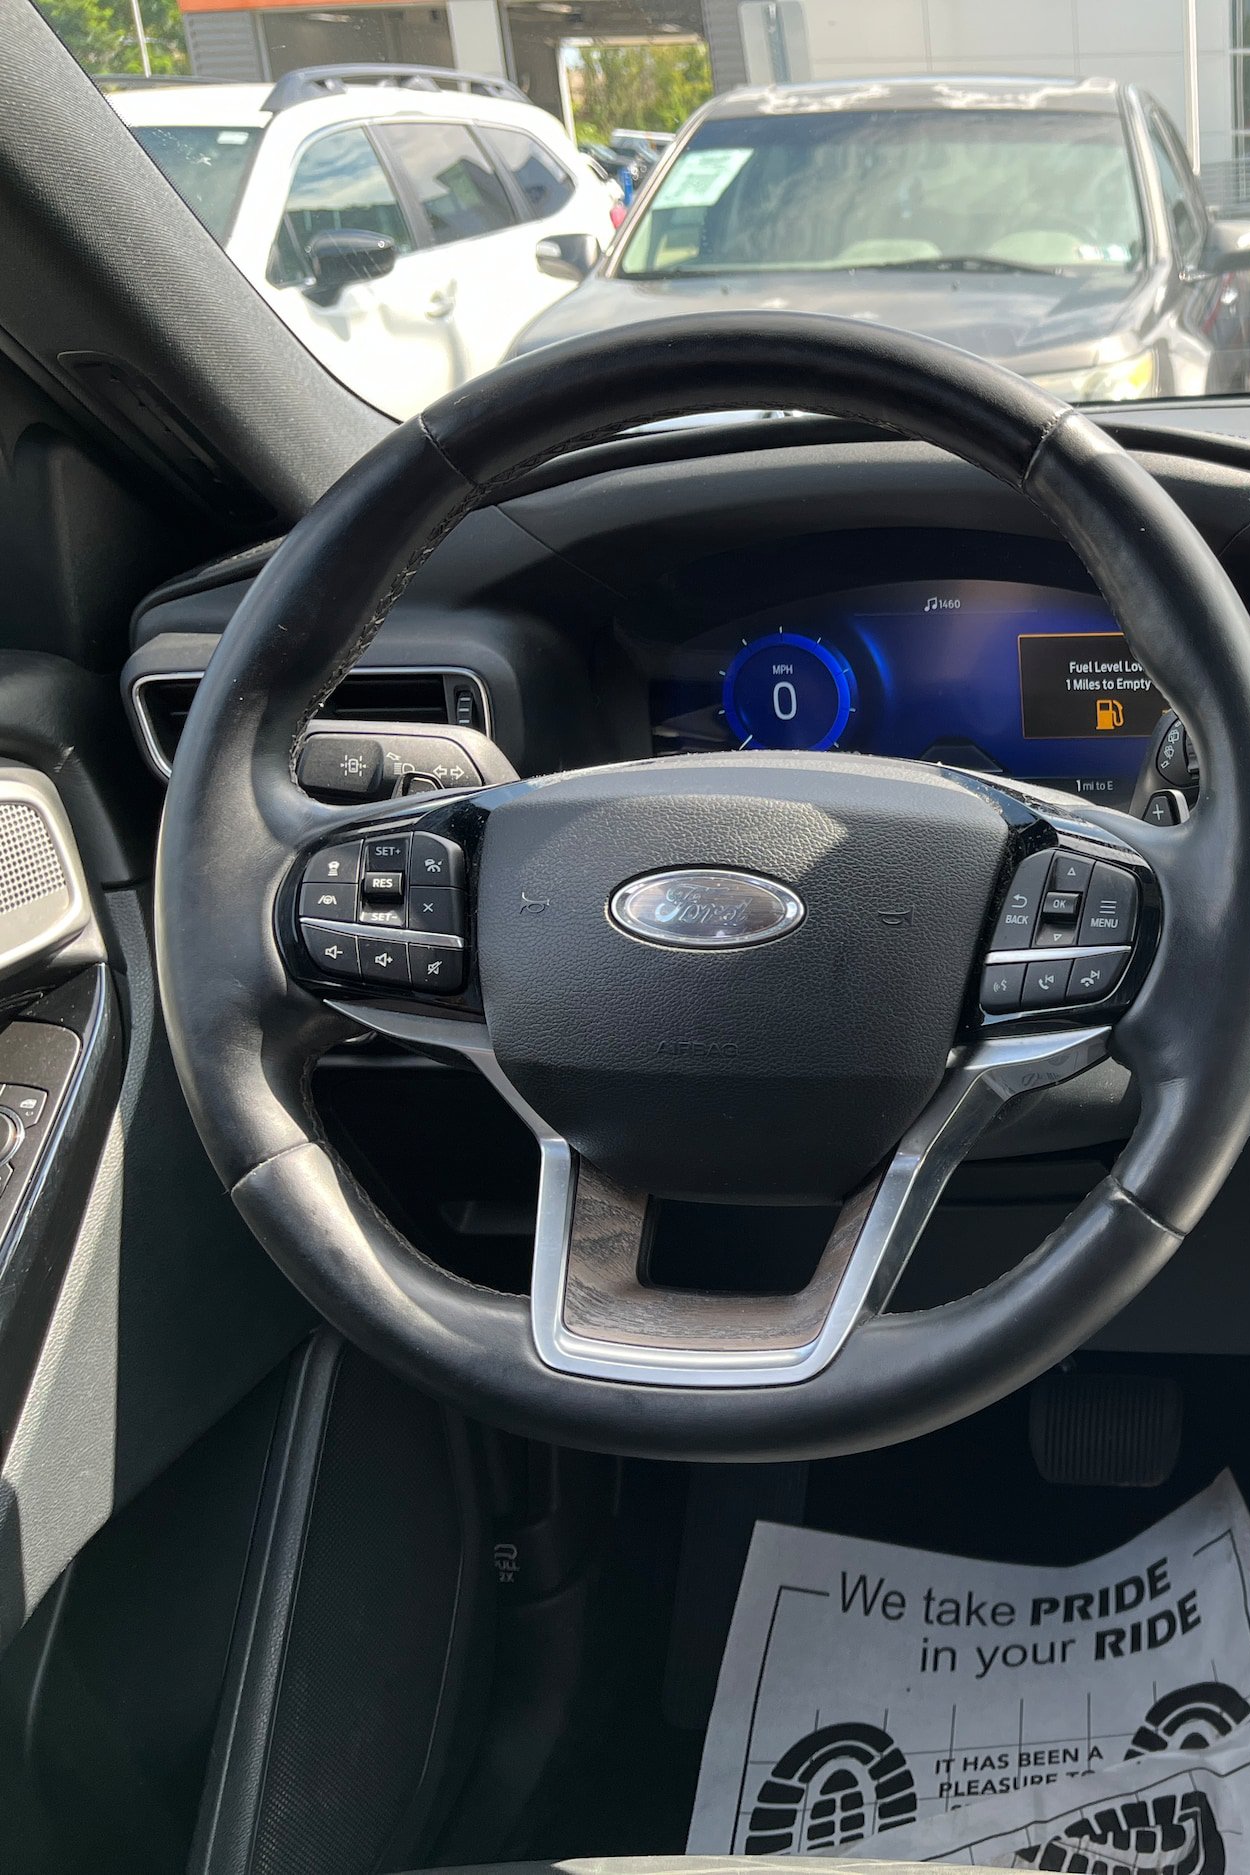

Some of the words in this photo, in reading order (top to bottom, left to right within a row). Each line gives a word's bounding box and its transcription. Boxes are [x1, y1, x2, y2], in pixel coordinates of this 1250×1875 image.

[939, 599, 961, 609] 1460
[772, 664, 793, 675] MPH
[1069, 661, 1093, 674] Fuel
[1094, 660, 1123, 673] Level
[1066, 679, 1071, 690] 1
[1073, 679, 1100, 690] Miles
[1102, 679, 1115, 690] to
[1116, 677, 1151, 691] Empty
[773, 681, 797, 720] 0
[1076, 780, 1081, 791] 1
[1083, 781, 1095, 790] mi
[1096, 781, 1106, 791] to
[1107, 781, 1114, 791] E
[372, 878, 393, 888] RES
[655, 883, 753, 923] Ford
[1053, 899, 1067, 909] OK
[1005, 915, 1029, 925] BACK
[1090, 918, 1119, 929] MENU
[840, 1571, 906, 1621] We
[923, 1587, 1016, 1626] take
[1030, 1557, 1172, 1626] PRIDE
[920, 1637, 956, 1672] in
[975, 1638, 1077, 1679] your
[1094, 1589, 1202, 1661] RIDE
[935, 1758, 955, 1775] IT
[962, 1754, 1009, 1772] HAS
[1018, 1748, 1079, 1768] BEEN
[1088, 1746, 1103, 1761] A
